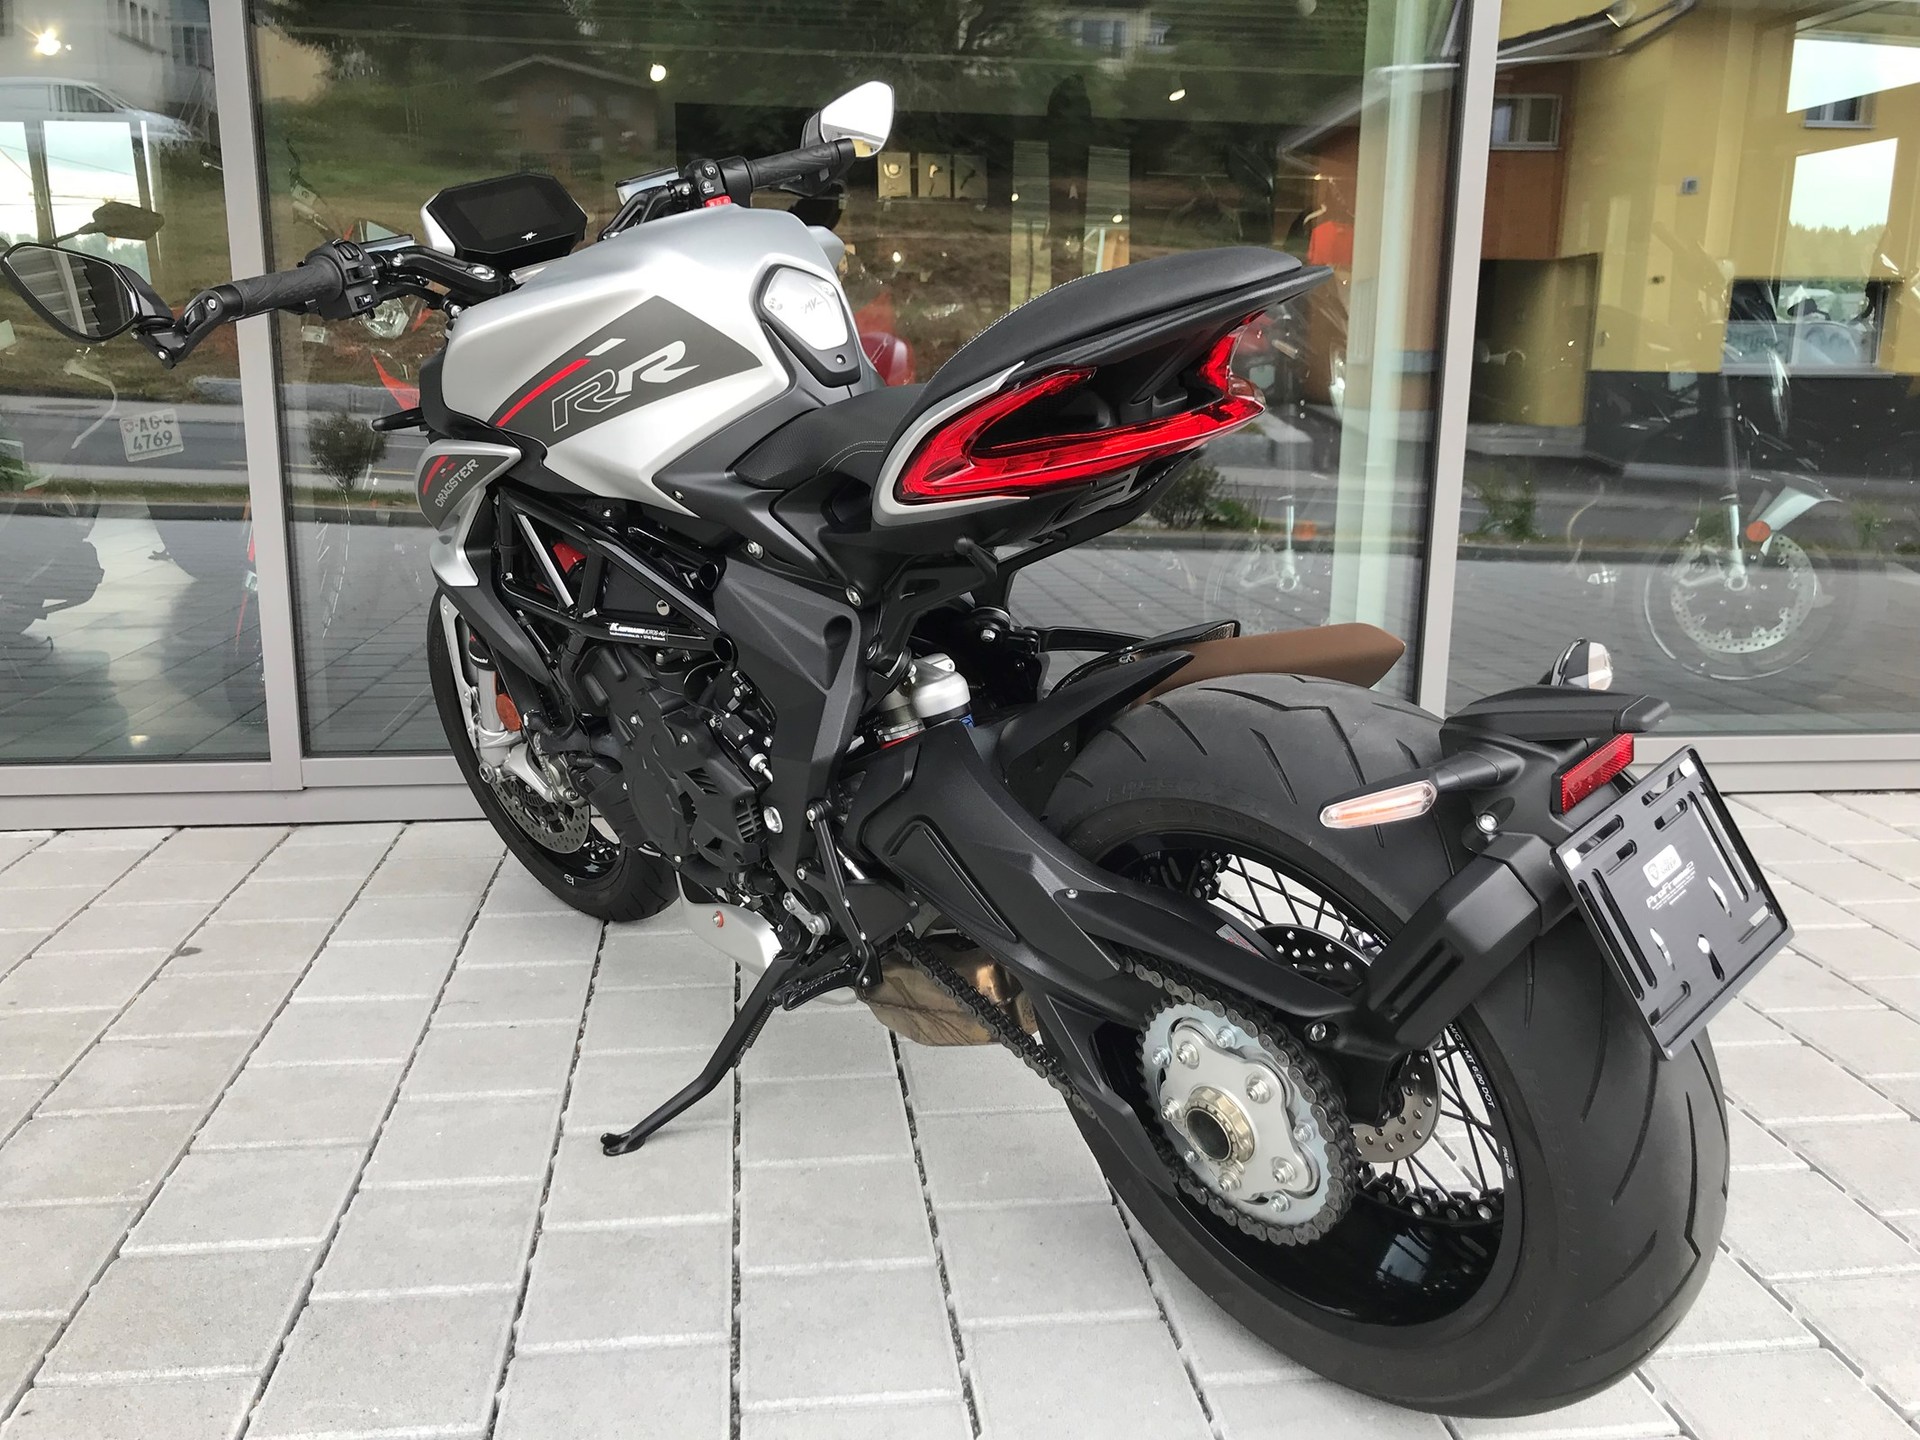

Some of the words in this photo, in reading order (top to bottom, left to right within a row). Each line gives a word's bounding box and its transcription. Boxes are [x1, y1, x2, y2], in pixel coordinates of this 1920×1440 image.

[551, 340, 700, 432] RR
[133, 430, 173, 450] 4769
[140, 415, 160, 432] AG
[434, 458, 480, 508] DRAGSTER
[1464, 1049, 1476, 1065] MT
[1471, 1065, 1485, 1086] 6.00
[1482, 1086, 1496, 1109] DOT
